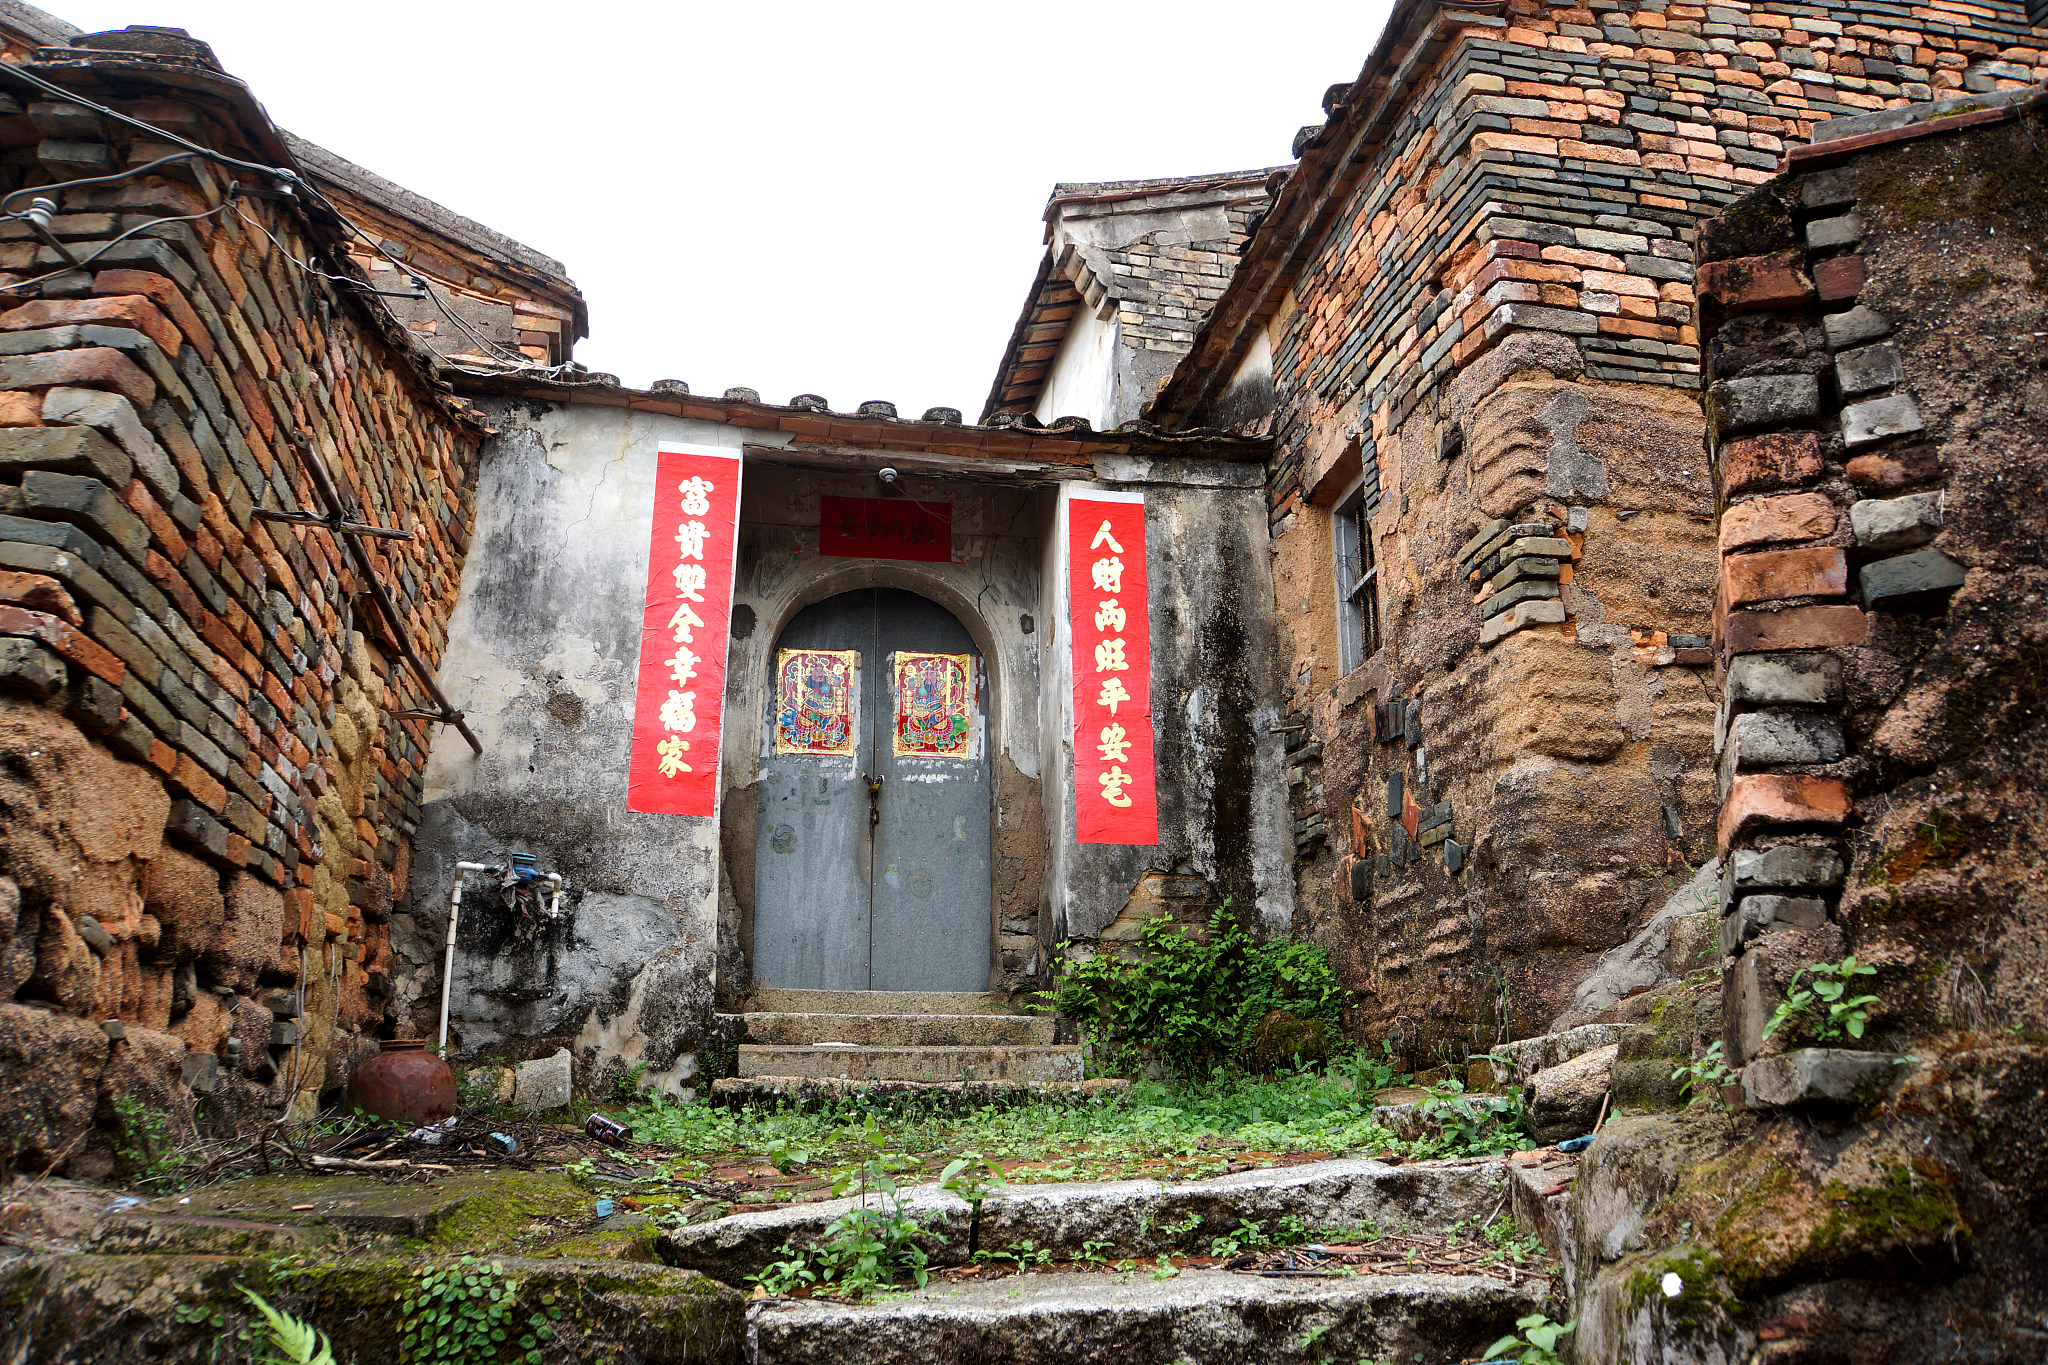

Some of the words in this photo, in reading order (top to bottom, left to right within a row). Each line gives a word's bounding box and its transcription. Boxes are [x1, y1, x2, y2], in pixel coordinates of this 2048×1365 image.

[656, 475, 715, 779] 富貴雙全幸福家
